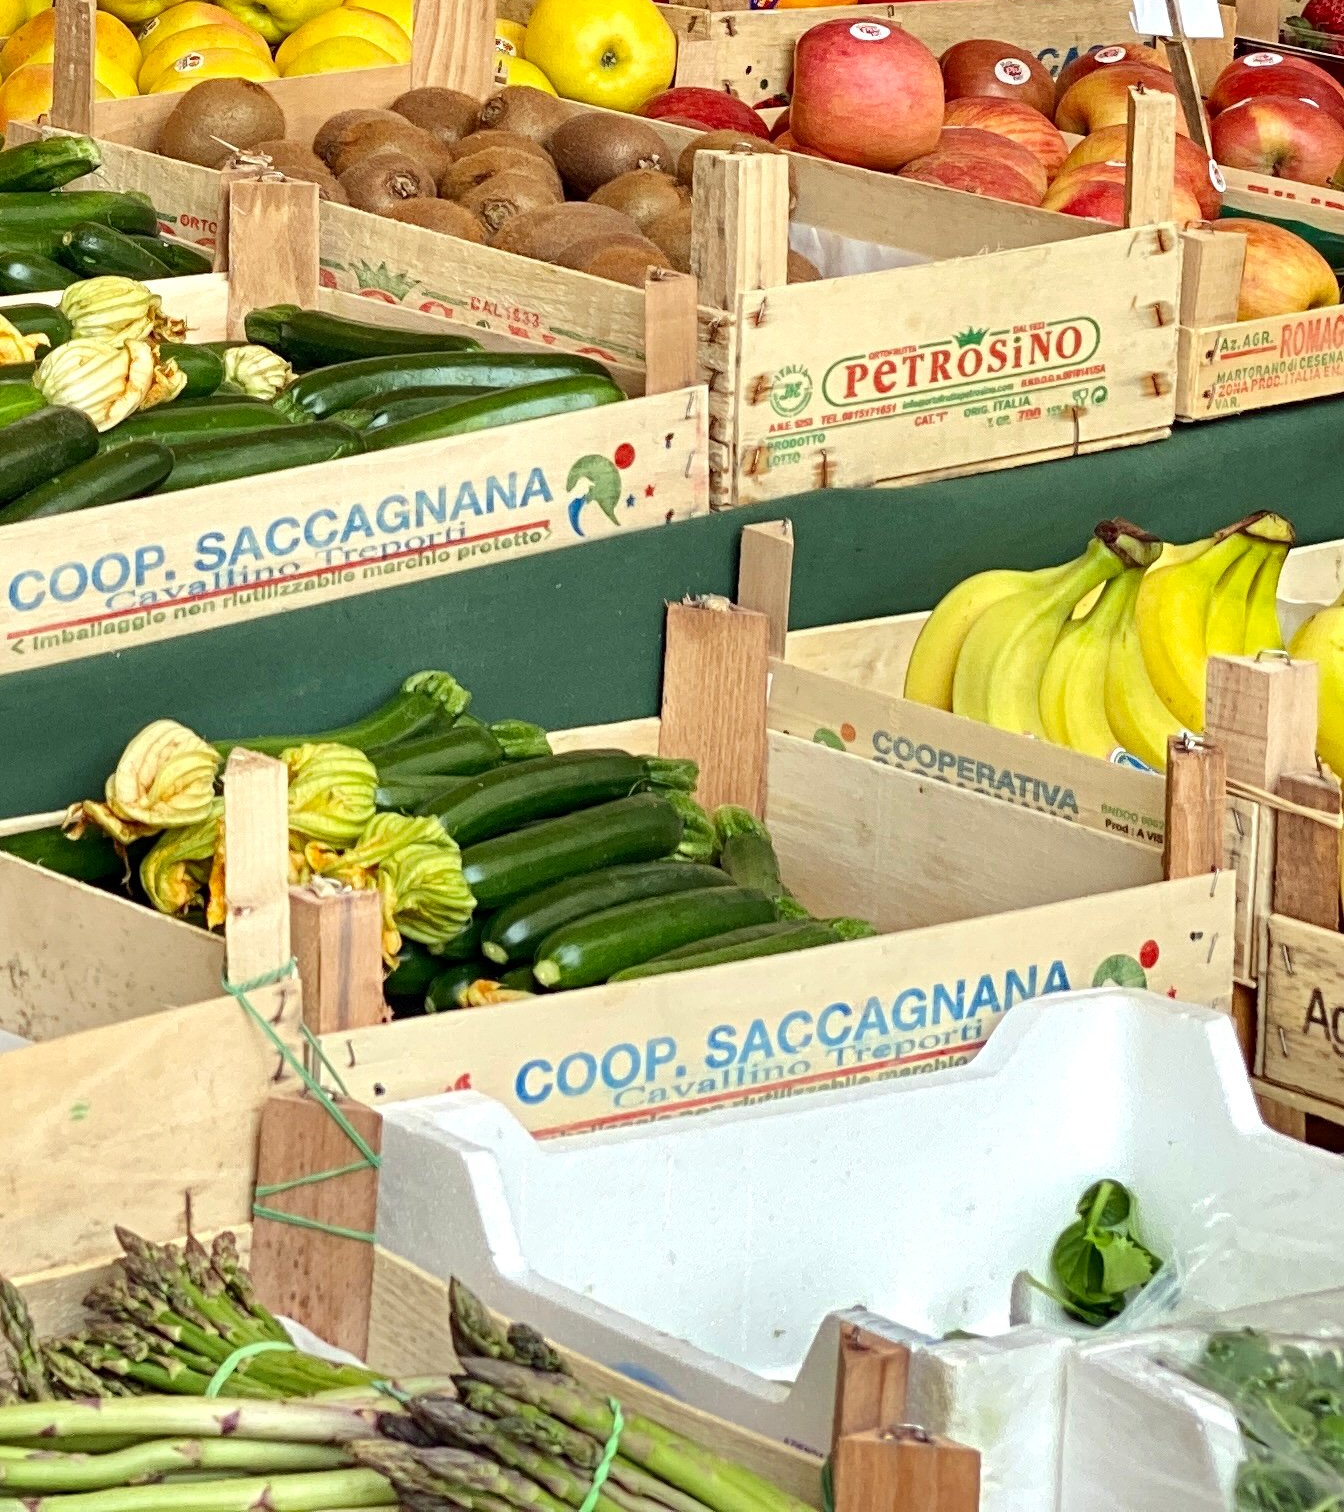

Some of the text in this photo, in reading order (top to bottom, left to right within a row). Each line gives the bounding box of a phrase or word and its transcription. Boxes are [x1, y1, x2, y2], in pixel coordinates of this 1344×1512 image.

[1243, 330, 1275, 350] AGR.
[993, 395, 1032, 412] ITALIA
[1218, 380, 1249, 398] ZONA
[8, 466, 554, 611] COOP. SACCAGNANA
[104, 520, 468, 609] Cavallino Treporti
[172, 595, 216, 621] non
[361, 540, 451, 581] marchio
[456, 523, 544, 564] protetto
[872, 728, 1080, 815] COOPERATIVA
[514, 959, 1073, 1106] COOP. SACCAGNANA
[612, 1019, 985, 1109] Cavallino Treporti
